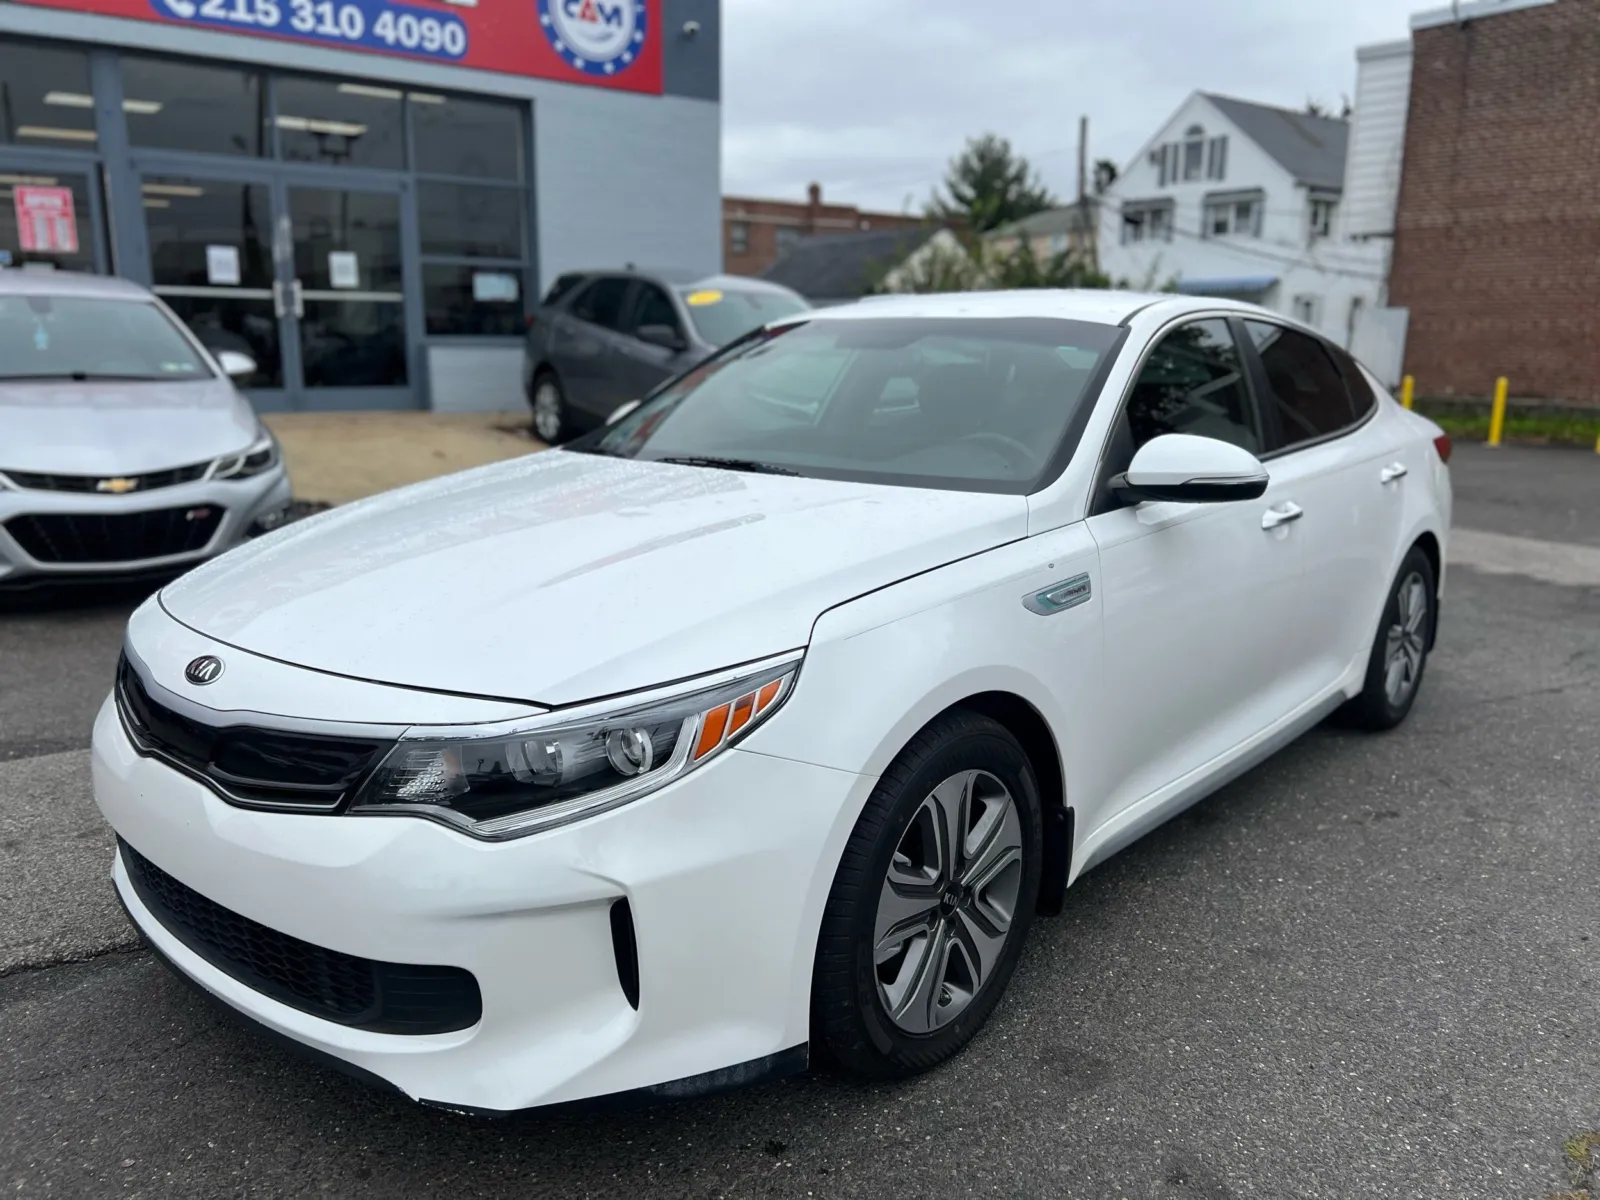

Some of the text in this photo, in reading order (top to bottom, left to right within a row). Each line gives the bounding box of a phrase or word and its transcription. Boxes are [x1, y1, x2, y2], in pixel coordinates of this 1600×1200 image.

[199, 0, 466, 55] 215 310 4090
